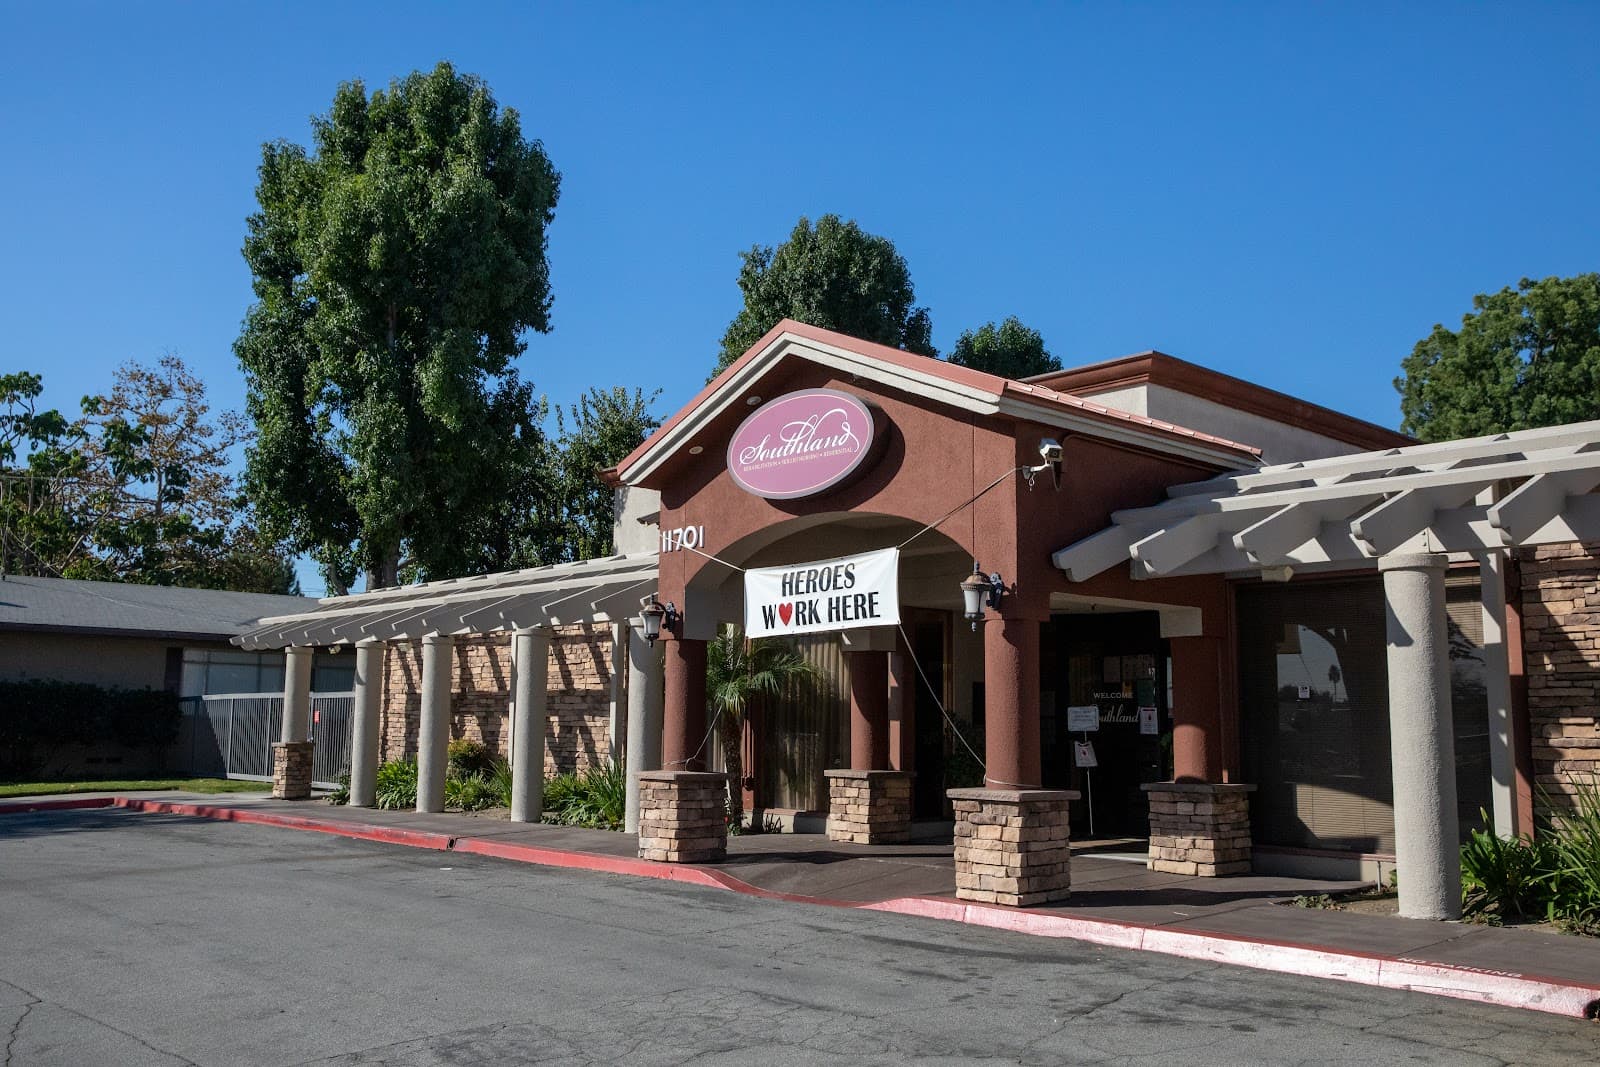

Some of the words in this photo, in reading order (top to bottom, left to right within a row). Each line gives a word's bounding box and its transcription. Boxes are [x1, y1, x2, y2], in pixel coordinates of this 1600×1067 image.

[739, 408, 860, 466] Southland
[662, 525, 704, 553] 11701
[781, 562, 856, 597] HEROES
[828, 591, 881, 622] HERE
